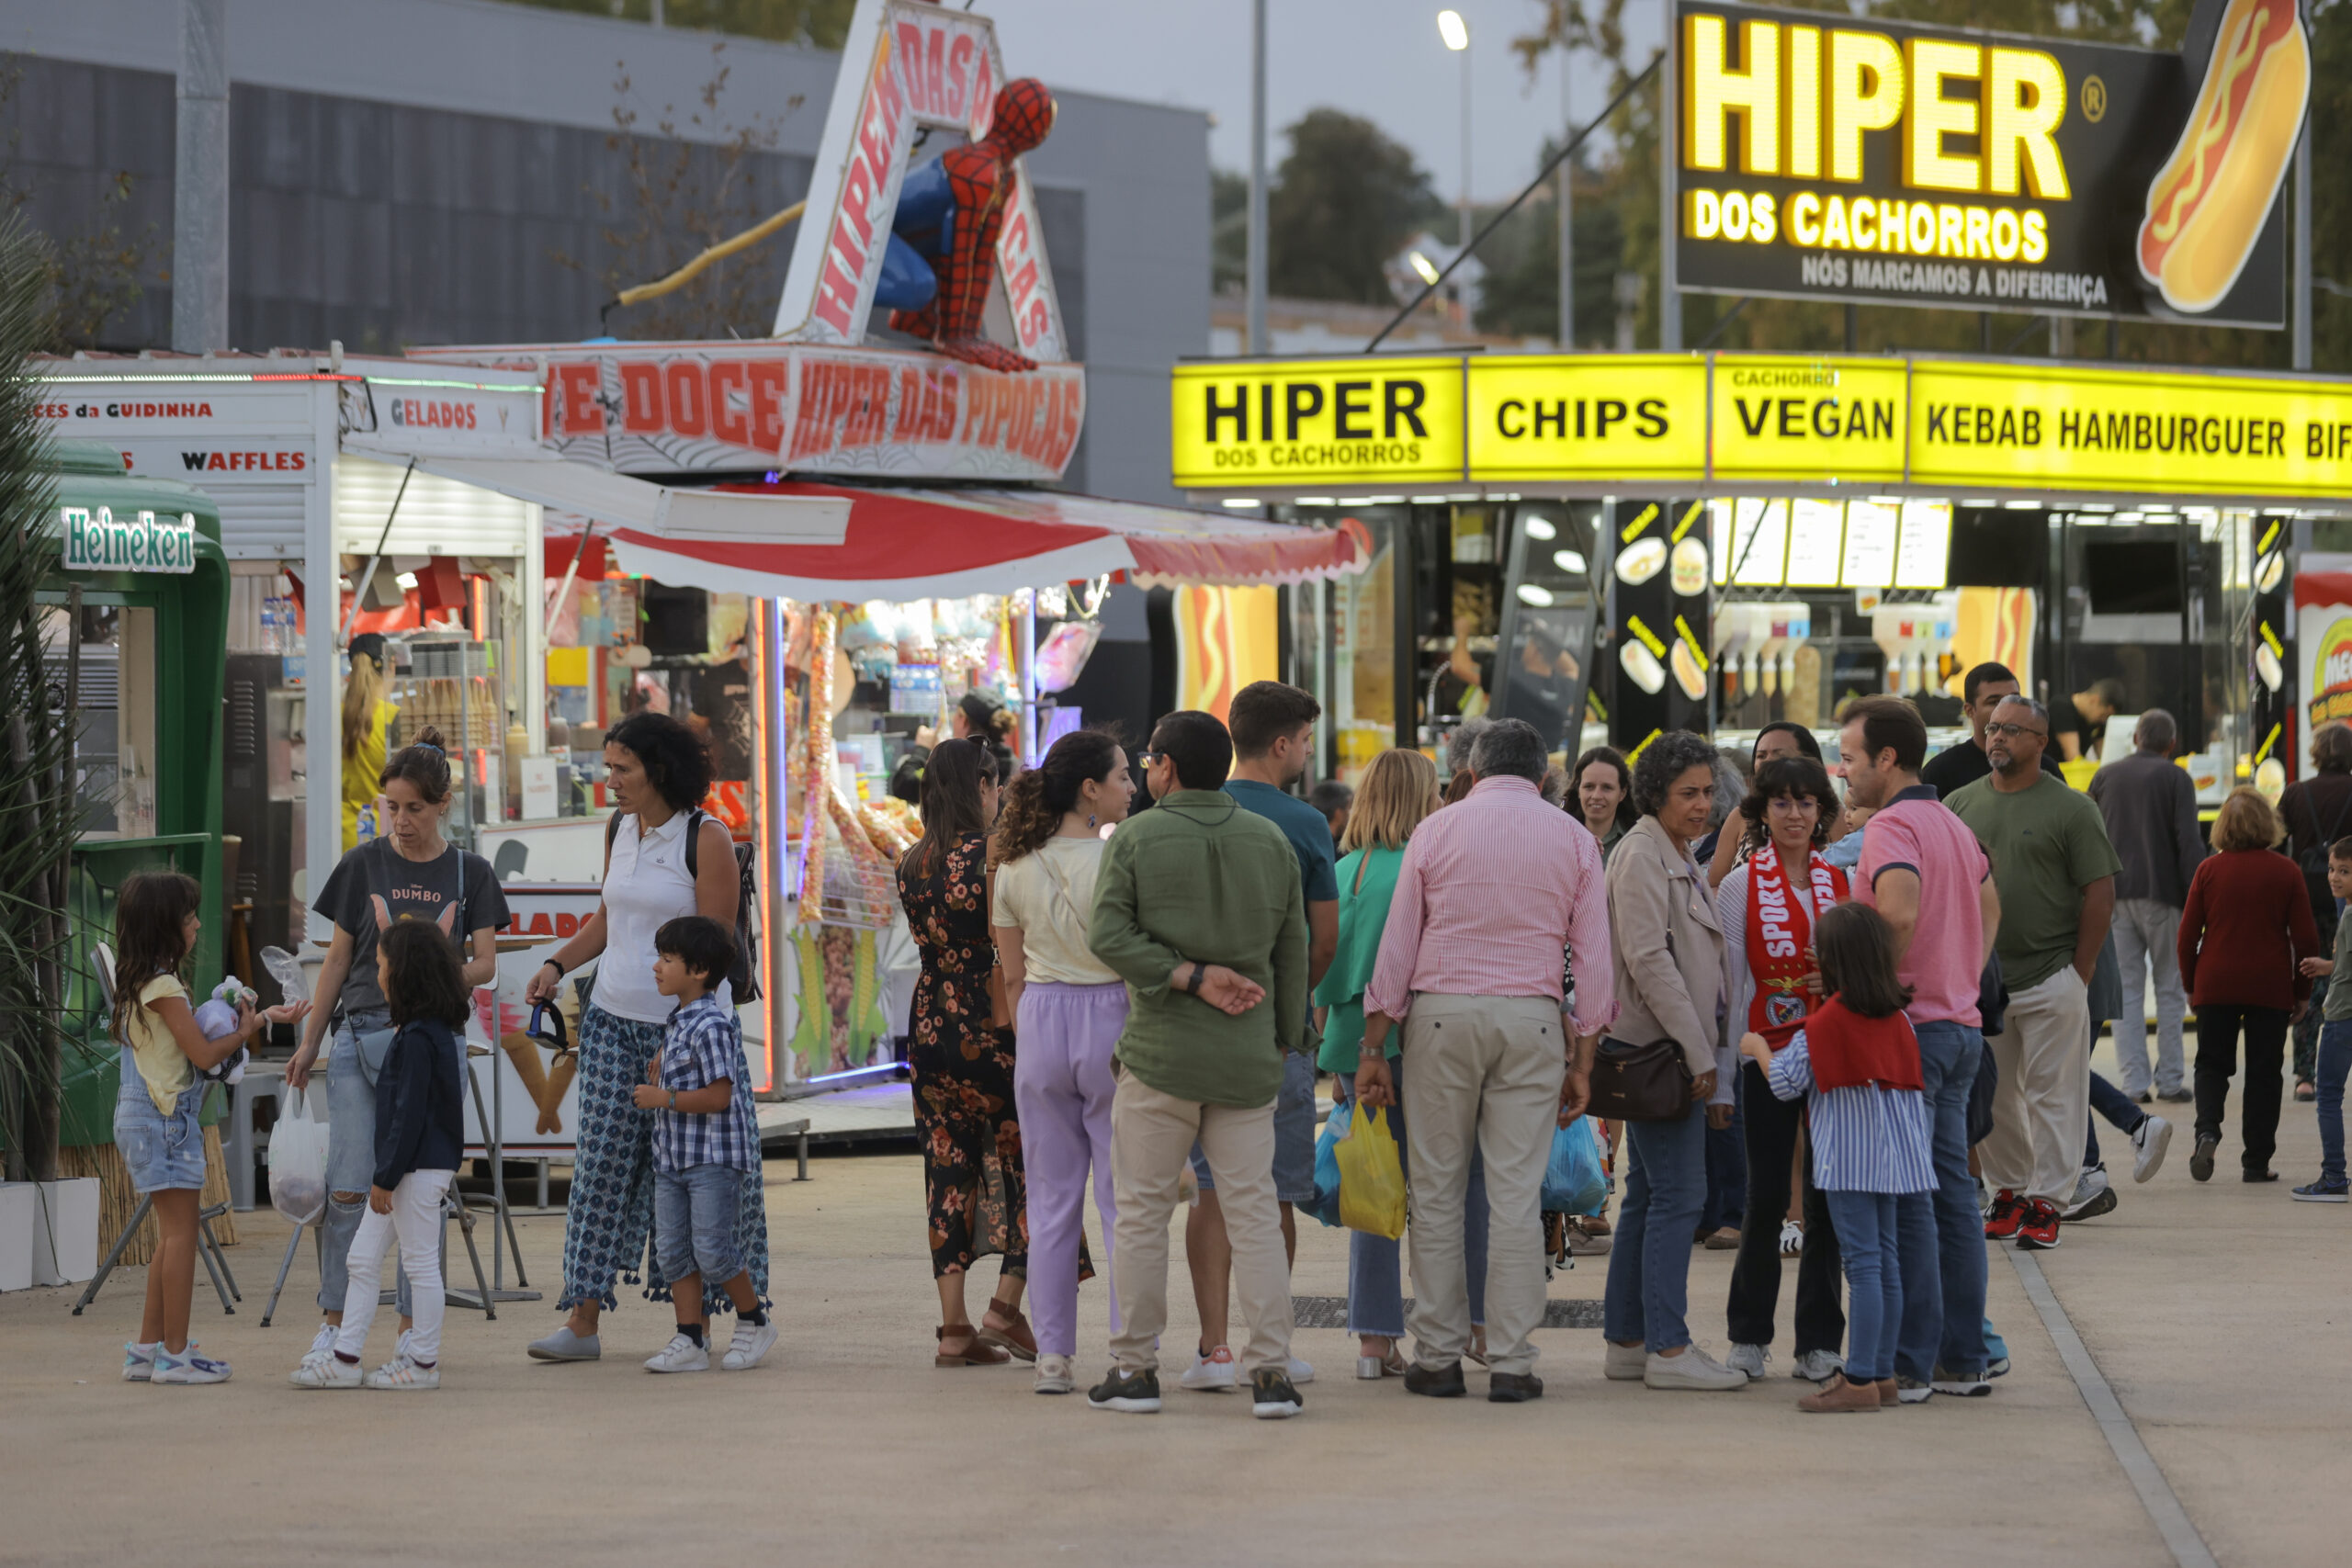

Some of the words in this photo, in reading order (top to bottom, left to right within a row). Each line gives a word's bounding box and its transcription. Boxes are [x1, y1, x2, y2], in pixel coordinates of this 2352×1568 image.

[1684, 13, 2071, 201] HIPER
[815, 30, 903, 338] HIPER
[898, 22, 974, 119] DAS
[1685, 188, 1777, 244] DOS
[1782, 190, 2049, 263] CACHORROS
[1802, 253, 1847, 287] NÓS
[1852, 258, 1972, 296] MARCAMOS
[1974, 266, 1991, 297] A
[1996, 268, 2108, 309] DIFERENÇA
[1733, 371, 1836, 388] CACHORRO
[75, 404, 99, 418] da
[107, 402, 213, 418] GUIDINHA
[391, 398, 477, 430] GELADOS
[617, 360, 787, 457] DOCE
[787, 358, 892, 462] HIPER
[891, 365, 959, 444] DAS
[960, 373, 1081, 472] PIPOCAS
[1204, 378, 1428, 443] HIPER
[1496, 398, 1669, 439] CHIPS
[1736, 398, 1894, 439] VEGAN
[1928, 404, 2041, 446] KEBAB
[2059, 410, 2286, 457] HAMBURGUER
[2307, 423, 2352, 460] BIF
[182, 452, 306, 470] WAFFLES
[1215, 449, 1258, 467] DOS
[1270, 443, 1421, 466] CACHORROS
[69, 513, 192, 568] Heineken
[391, 888, 441, 902] DUMBO
[1756, 875, 1797, 958] SPORT
